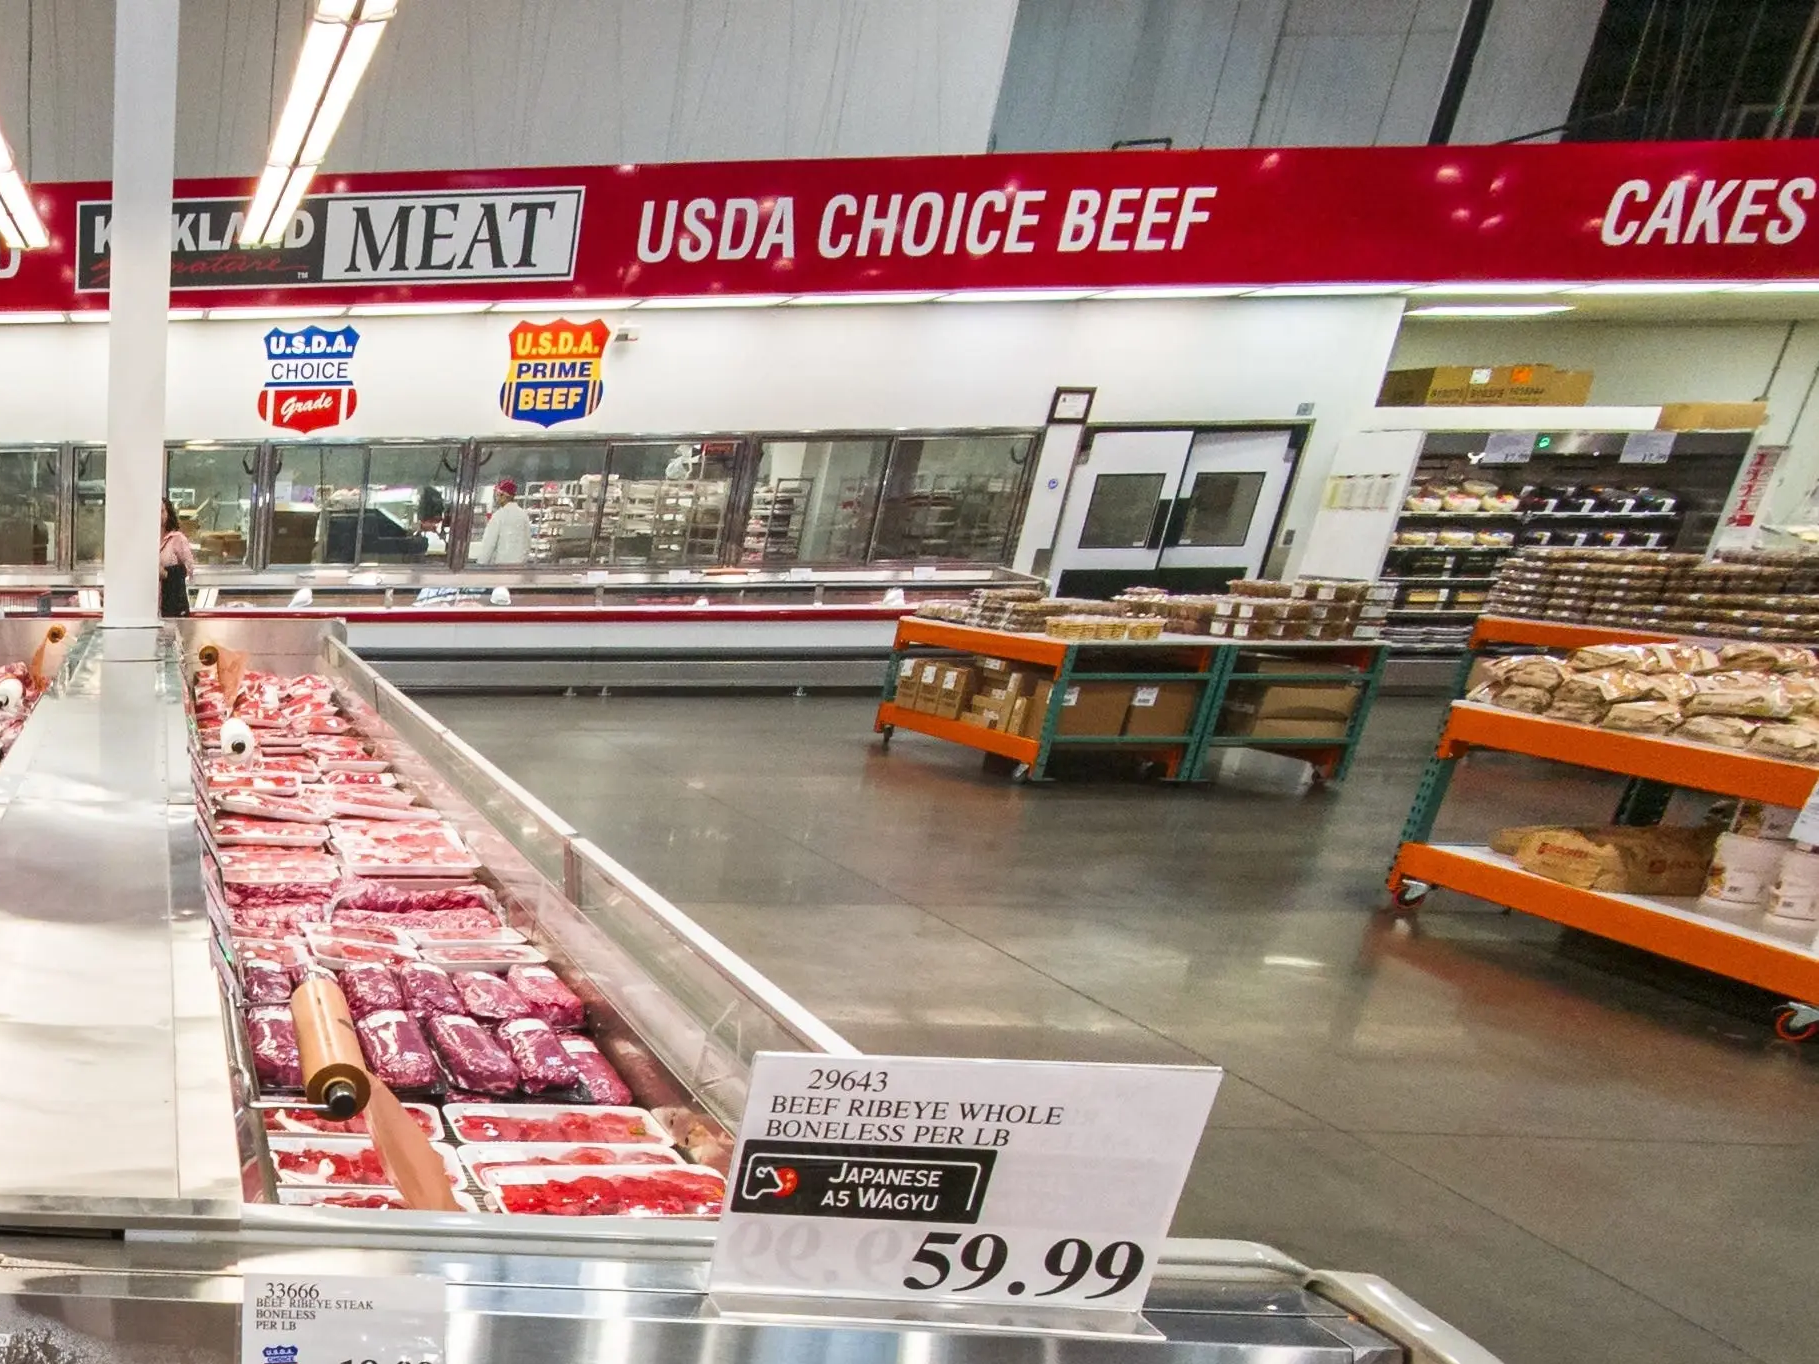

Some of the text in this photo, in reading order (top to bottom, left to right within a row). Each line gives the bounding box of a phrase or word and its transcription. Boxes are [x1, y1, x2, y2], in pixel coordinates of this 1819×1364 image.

[1600, 177, 1818, 246] CAKES
[93, 209, 315, 254] KKLAD
[344, 201, 556, 273] MEAT
[636, 186, 1217, 263] USDA CHOICE BEEF
[269, 334, 353, 354] U.S.D.A.
[516, 332, 600, 354] U.S.D.A.
[271, 361, 349, 380] CHOICE
[516, 361, 593, 379] PRIME
[280, 394, 334, 423] Grade
[518, 388, 584, 411] BEEF
[808, 1069, 889, 1093] 29643
[771, 1095, 1064, 1126] BEEF RIBEYE WHOLE
[765, 1119, 1011, 1147] BONELESS PER LB
[828, 1161, 943, 1188] JAPANESE
[820, 1186, 939, 1212] A5 WAGYU
[902, 1231, 1146, 1300] 59.99
[265, 1282, 320, 1300] 33666
[256, 1298, 374, 1311] BEEF RIBEYE STEAK
[256, 1309, 316, 1320] BONELESS
[256, 1320, 297, 1331] PER LB
